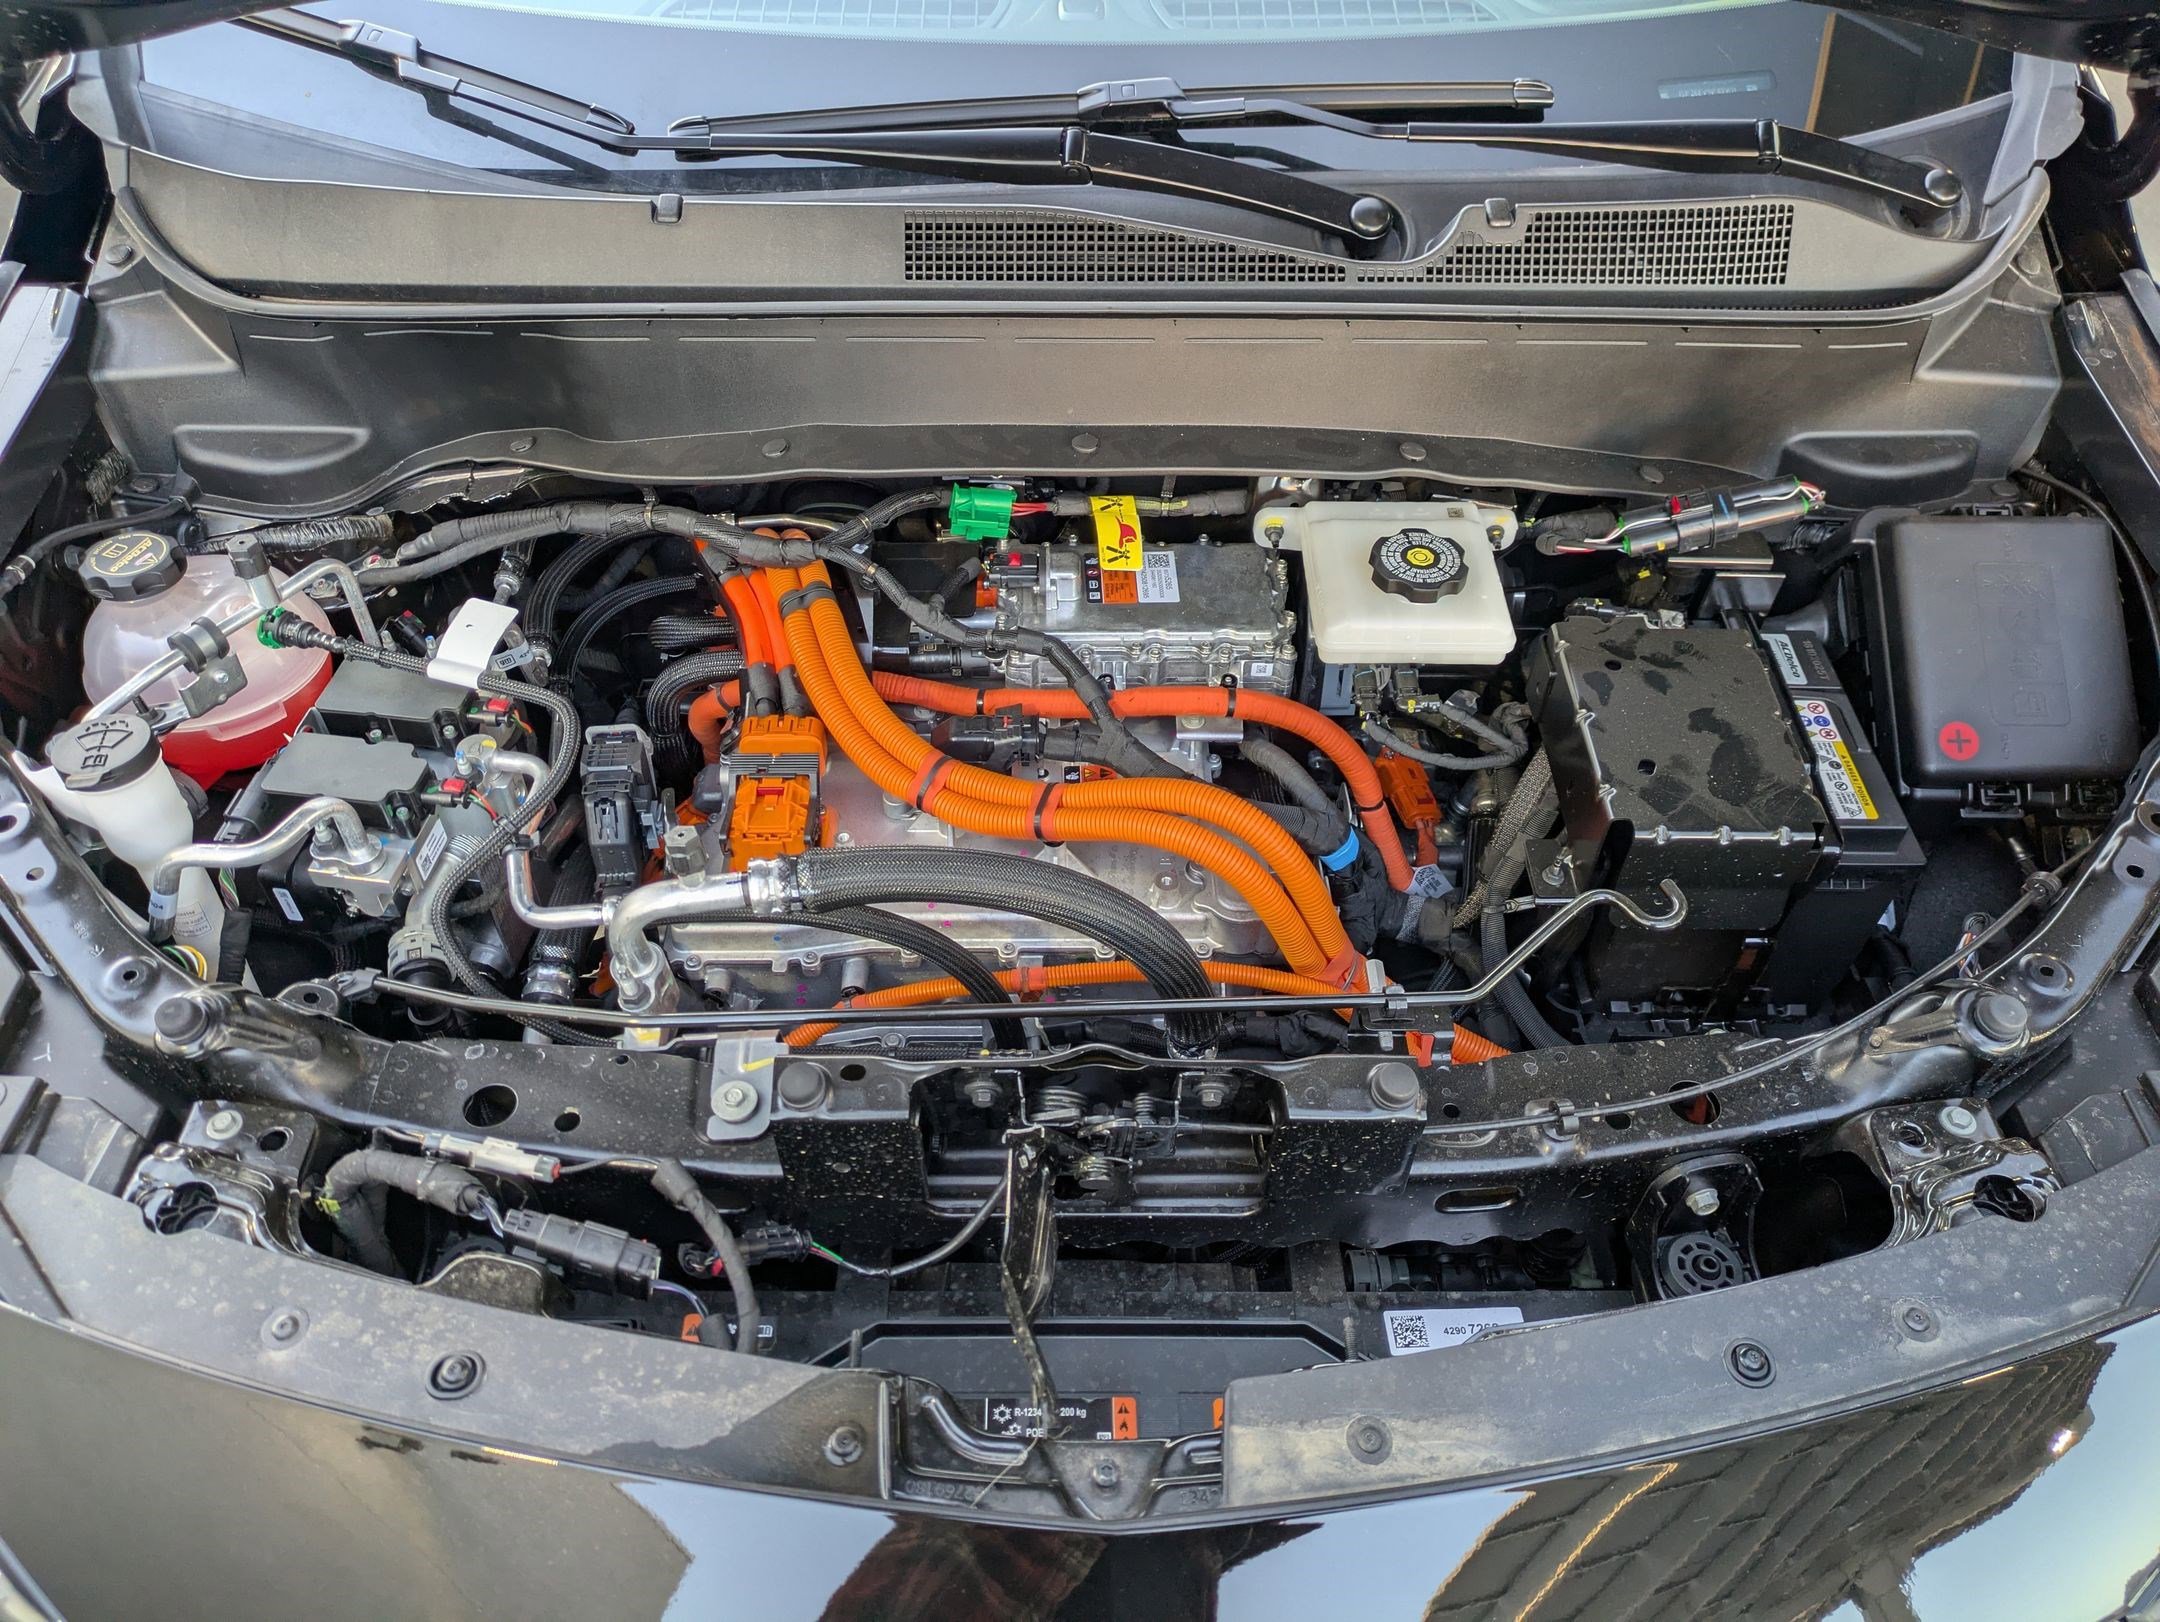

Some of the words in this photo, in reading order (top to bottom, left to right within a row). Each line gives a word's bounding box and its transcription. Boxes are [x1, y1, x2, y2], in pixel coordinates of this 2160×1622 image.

[110, 537, 153, 573] ACDelco
[1779, 640, 1800, 678] ACDelco
[1443, 1327, 1467, 1335] 4290
[1076, 1408, 1087, 1418] kg
